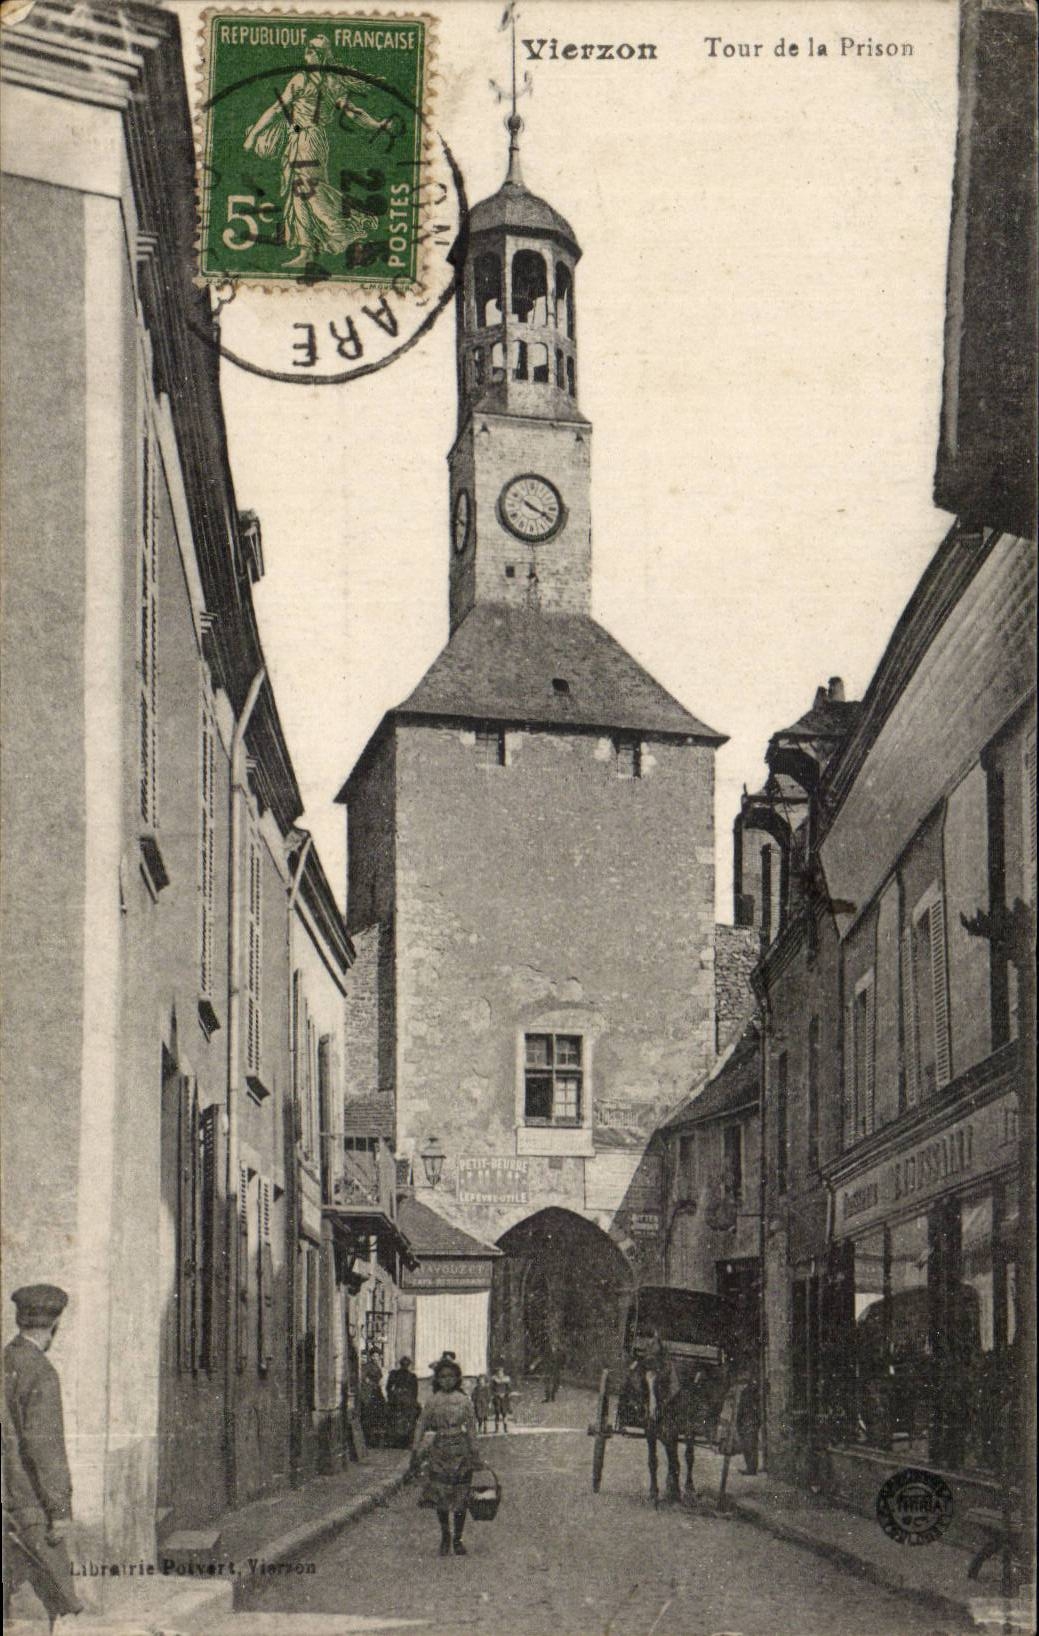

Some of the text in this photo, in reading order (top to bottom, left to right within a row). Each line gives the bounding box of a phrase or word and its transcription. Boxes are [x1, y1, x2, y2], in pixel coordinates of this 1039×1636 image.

[220, 25, 416, 50] REPUBLIQUE FRANÇAISE
[387, 183, 411, 267] POSTES
